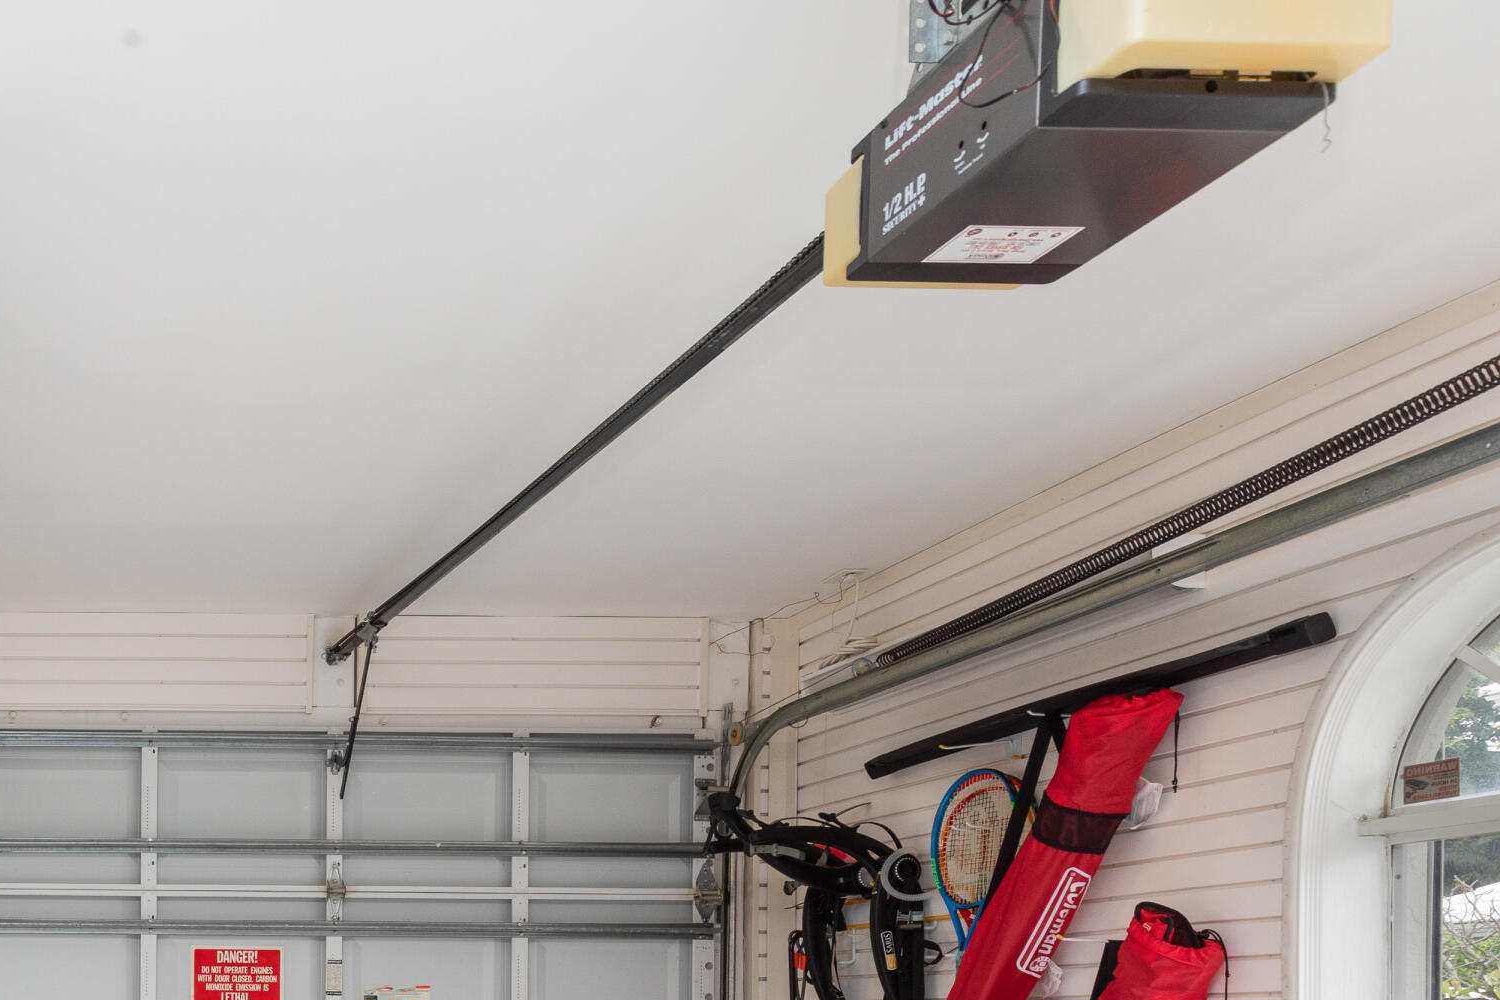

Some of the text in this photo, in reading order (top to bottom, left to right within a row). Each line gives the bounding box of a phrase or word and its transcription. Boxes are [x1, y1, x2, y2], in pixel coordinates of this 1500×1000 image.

[901, 95, 960, 152] Professional
[882, 191, 902, 222] 1/2
[1038, 881, 1086, 955] Coleman
[216, 950, 258, 964] DANGER!
[224, 966, 248, 974] OPERATE
[250, 966, 274, 974] ENGINES
[232, 974, 254, 982] CLOSED.
[236, 984, 262, 992] EMISSION
